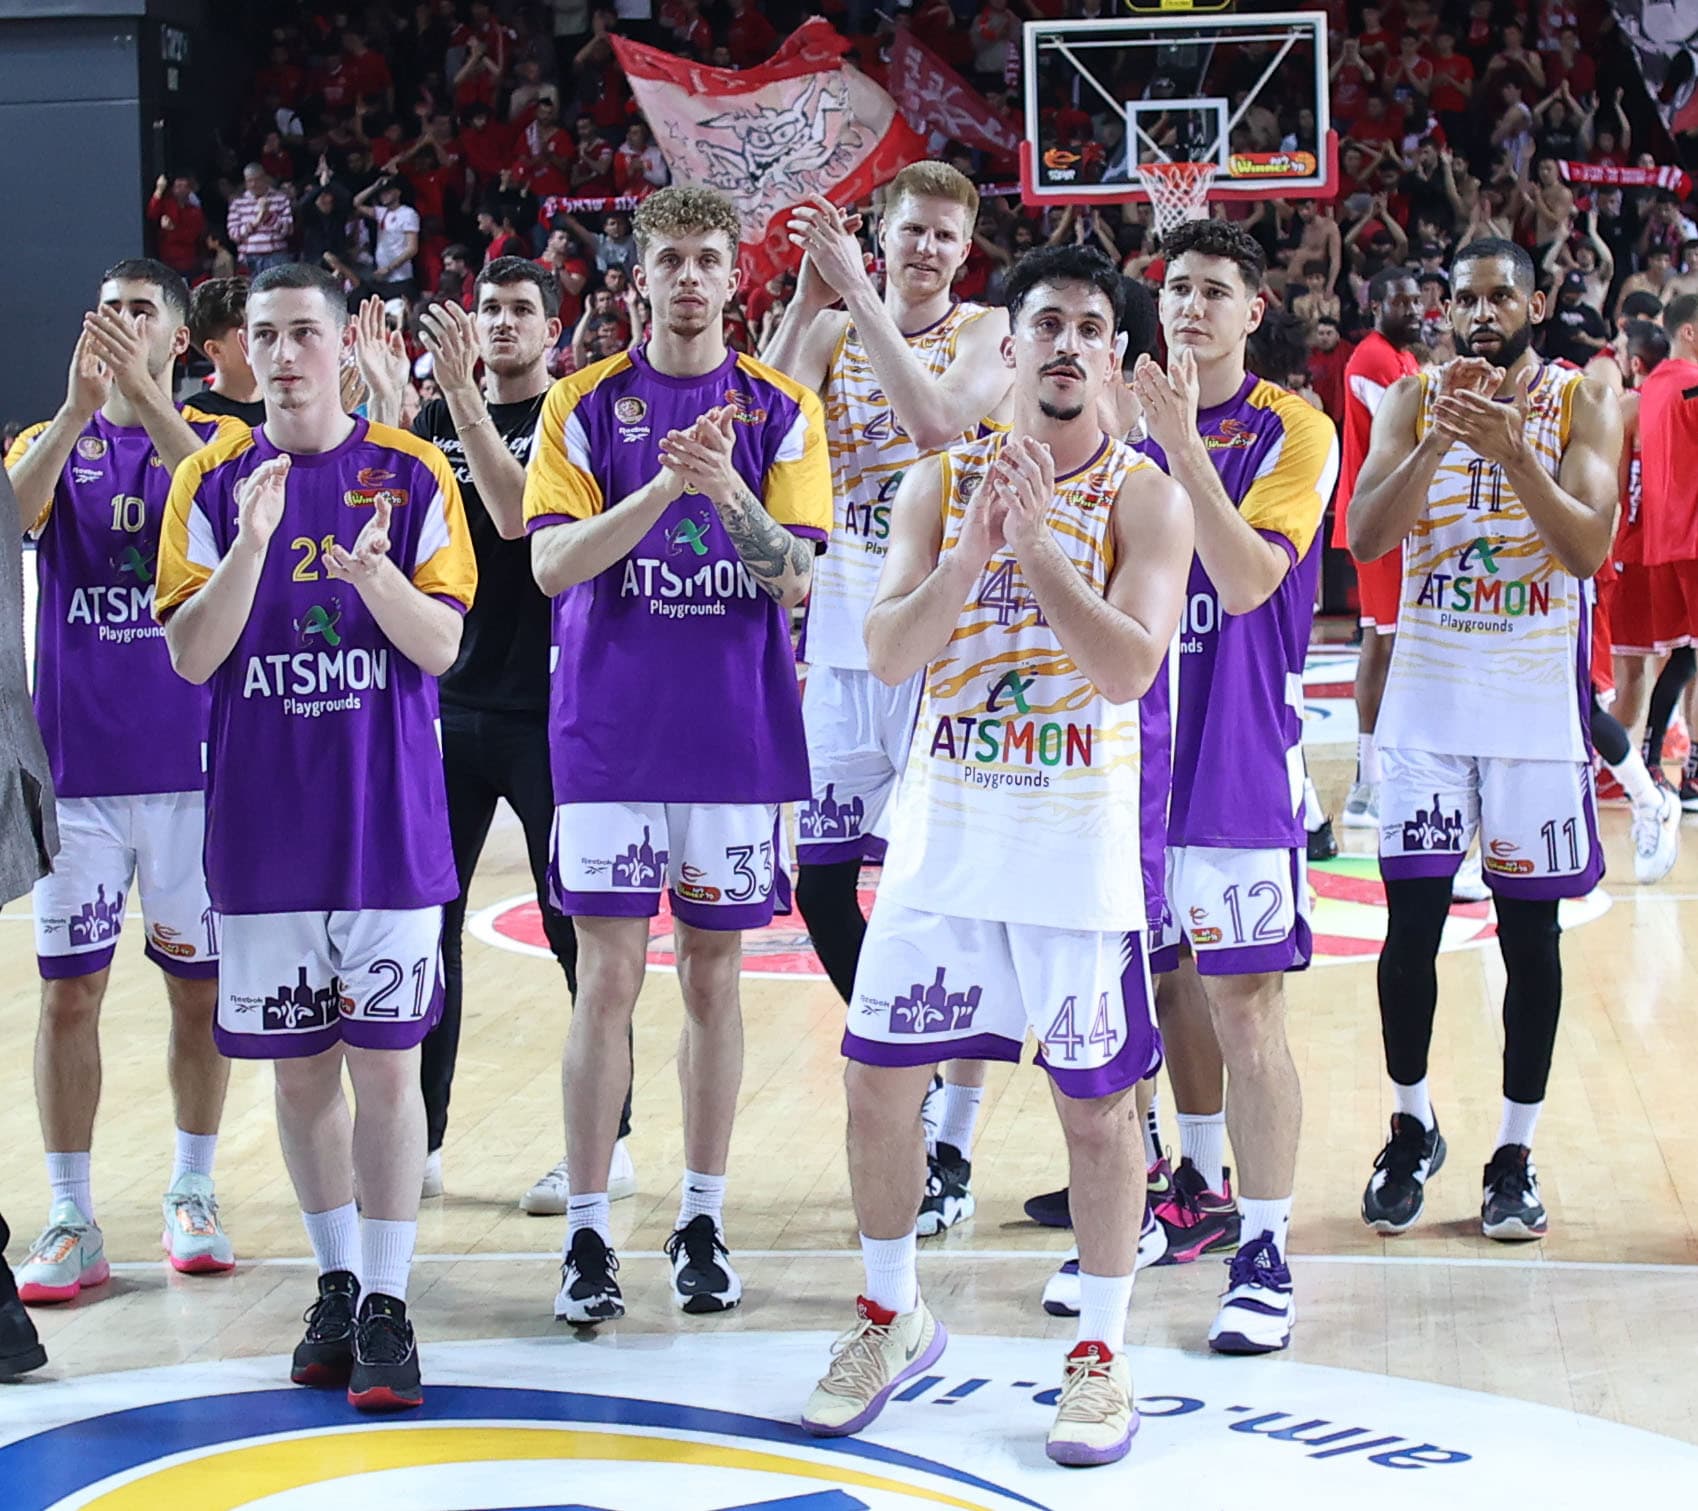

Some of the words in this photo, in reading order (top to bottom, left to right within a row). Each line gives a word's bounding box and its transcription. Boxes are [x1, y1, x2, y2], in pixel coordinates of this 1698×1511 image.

[1467, 458, 1502, 513] 11
[111, 493, 145, 533] 10
[845, 501, 892, 540] ATS
[621, 558, 759, 600] ATSMON
[1417, 572, 1549, 617] ATSMON
[67, 584, 156, 625] ATSM
[650, 600, 726, 619] Playgrounds
[1440, 612, 1514, 633] Playgrounds
[99, 624, 166, 644] Playground
[243, 648, 387, 698] ATSMON
[284, 692, 361, 718] Playgrounds
[930, 715, 1092, 767] ATSMON
[964, 766, 1050, 790] Playgrounds
[1541, 817, 1582, 873] 11
[725, 840, 774, 902] 33
[201, 907, 219, 956] 1
[1223, 881, 1286, 944] 12
[364, 957, 429, 1018] 21
[1044, 991, 1118, 1061] 44
